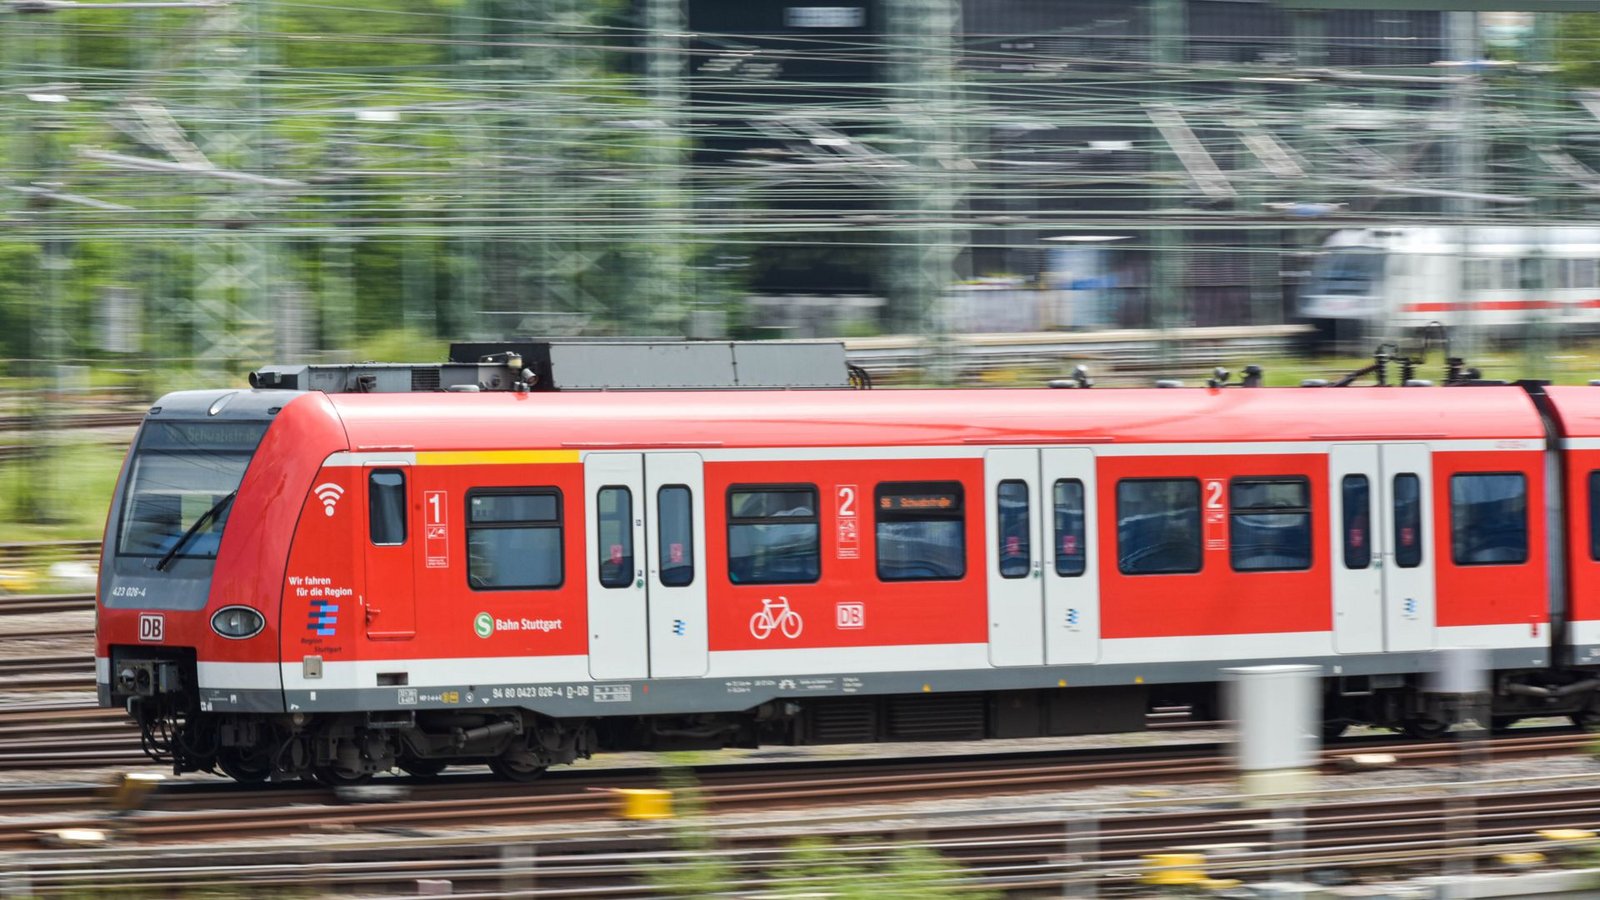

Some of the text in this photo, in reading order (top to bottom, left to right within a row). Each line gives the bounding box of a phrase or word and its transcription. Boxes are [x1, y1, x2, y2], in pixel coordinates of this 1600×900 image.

[838, 486, 856, 516] 2
[1206, 481, 1224, 509] 2
[428, 493, 440, 523] 1
[288, 576, 331, 586] Wir fahren
[112, 586, 147, 598] 423 026-4
[296, 587, 353, 598] für die Region
[840, 607, 860, 625] DB
[142, 618, 161, 638] DB
[496, 618, 519, 631] Bahn
[521, 617, 562, 633] Stuttgart
[492, 688, 503, 699] 94
[505, 687, 515, 698] 80
[517, 686, 536, 698] 0423
[538, 686, 563, 697] 026-4
[566, 685, 589, 699] D-DB
